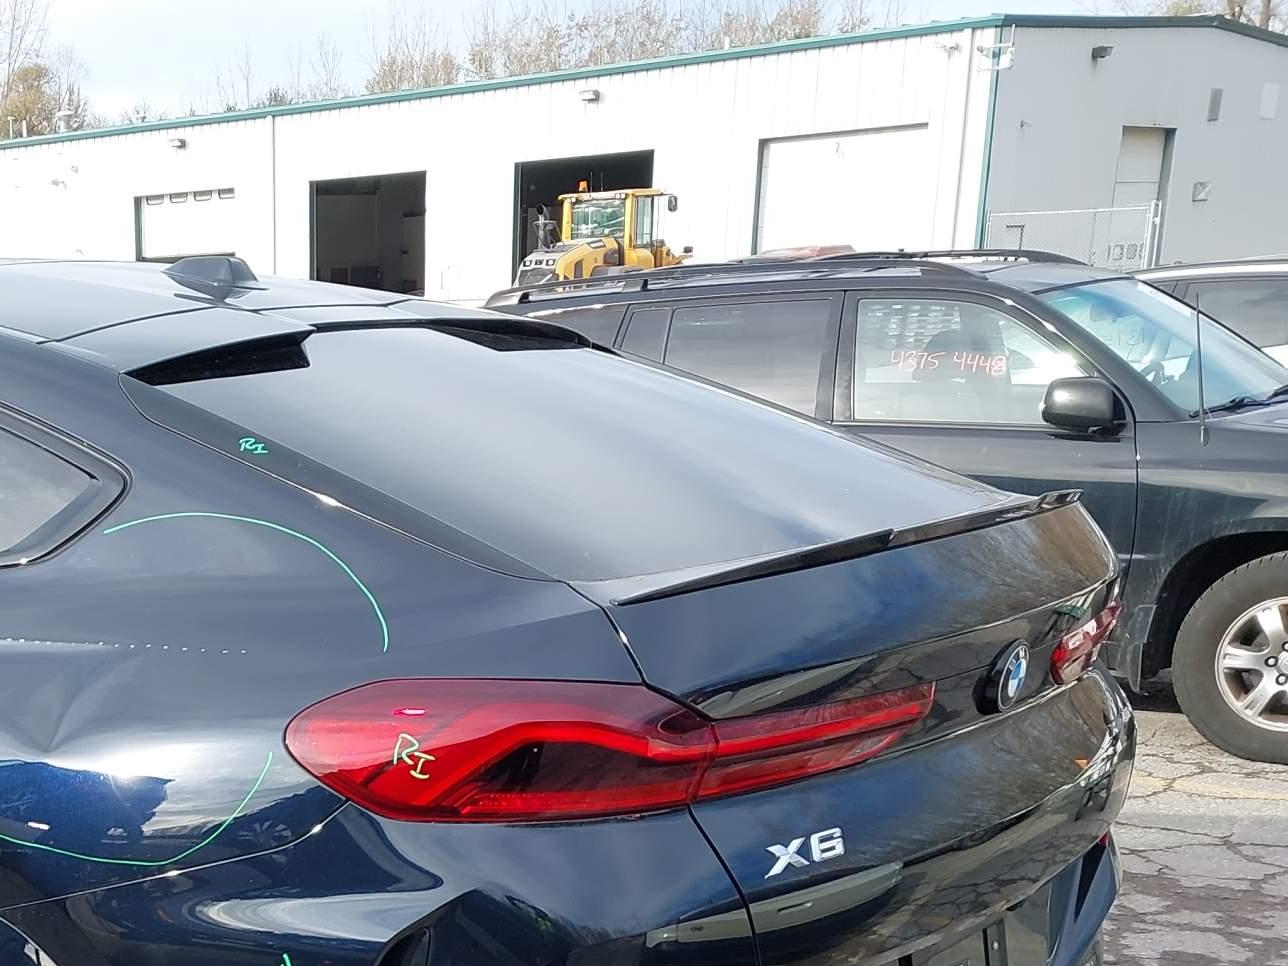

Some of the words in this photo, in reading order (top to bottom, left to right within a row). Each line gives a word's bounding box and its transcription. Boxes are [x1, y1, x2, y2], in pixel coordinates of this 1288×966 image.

[891, 350, 947, 373] 4375
[953, 351, 1007, 376] 4448
[393, 732, 436, 780] RI
[764, 827, 846, 880] X6
